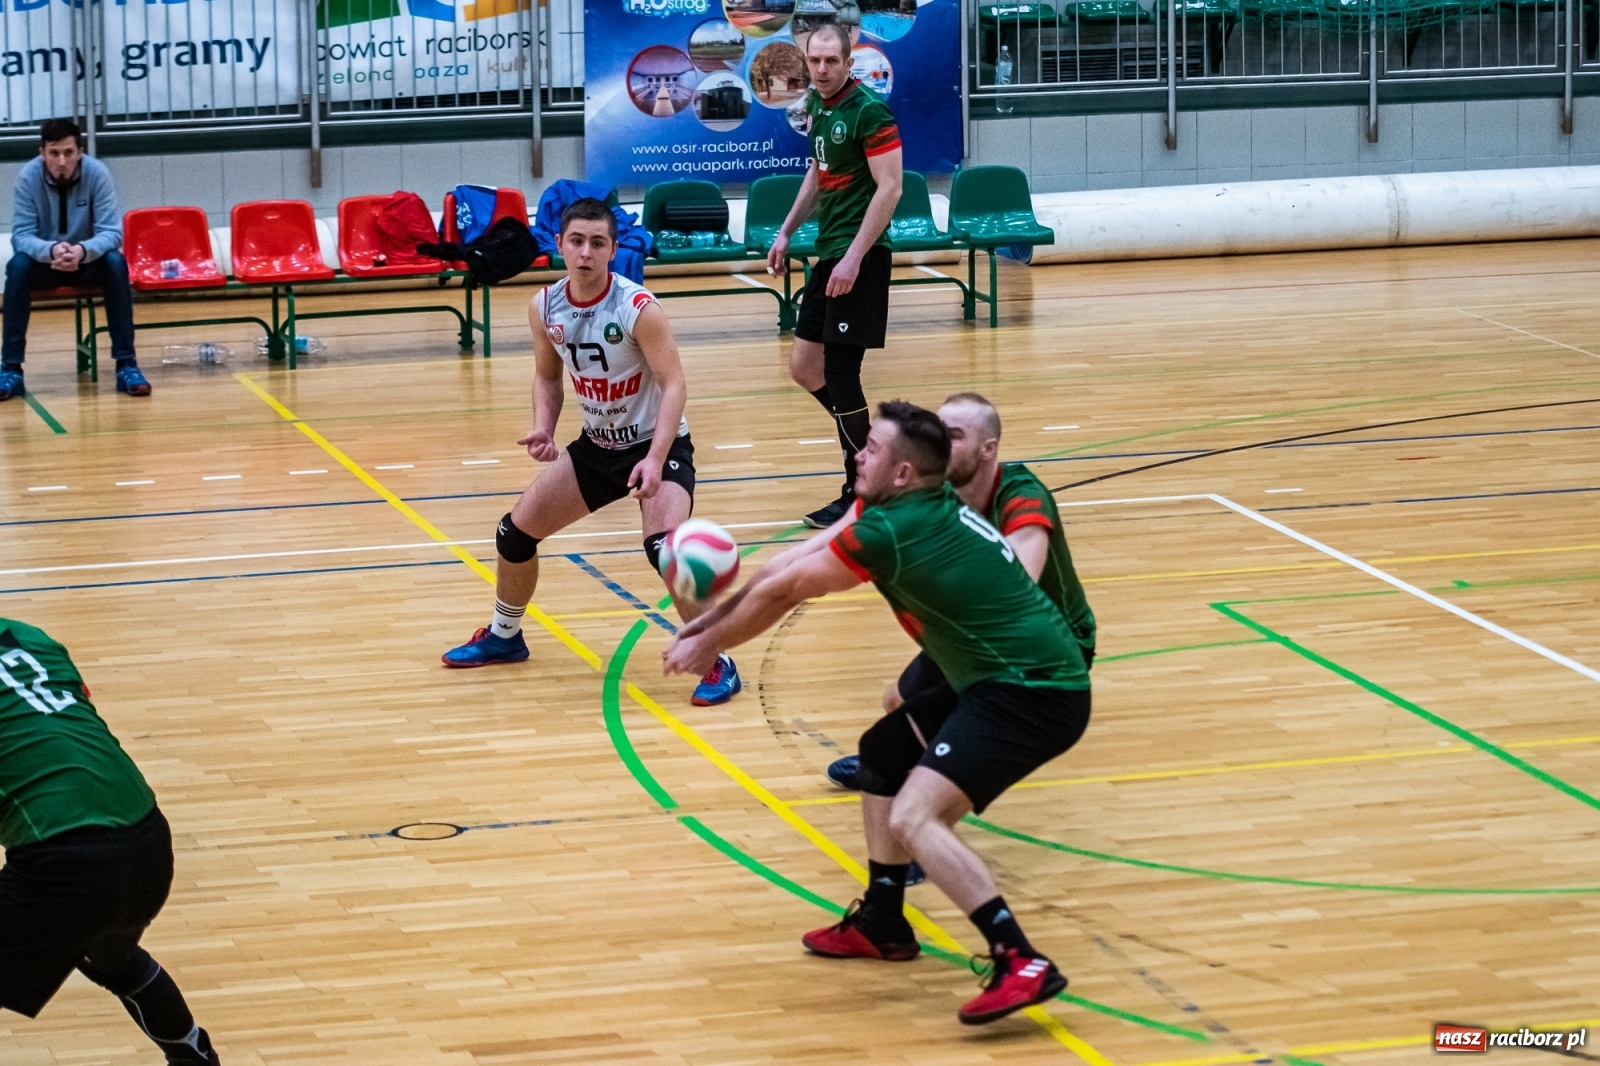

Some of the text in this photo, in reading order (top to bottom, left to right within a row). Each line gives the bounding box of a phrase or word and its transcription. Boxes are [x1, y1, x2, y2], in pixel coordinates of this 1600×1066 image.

[121, 37, 271, 81] gramy
[631, 138, 774, 155] www.osir-raciborz.pl
[631, 155, 816, 174] www.aquapark.raciborz.p
[566, 342, 610, 373] 17
[606, 405, 628, 416] PBG
[0, 648, 78, 716] 12
